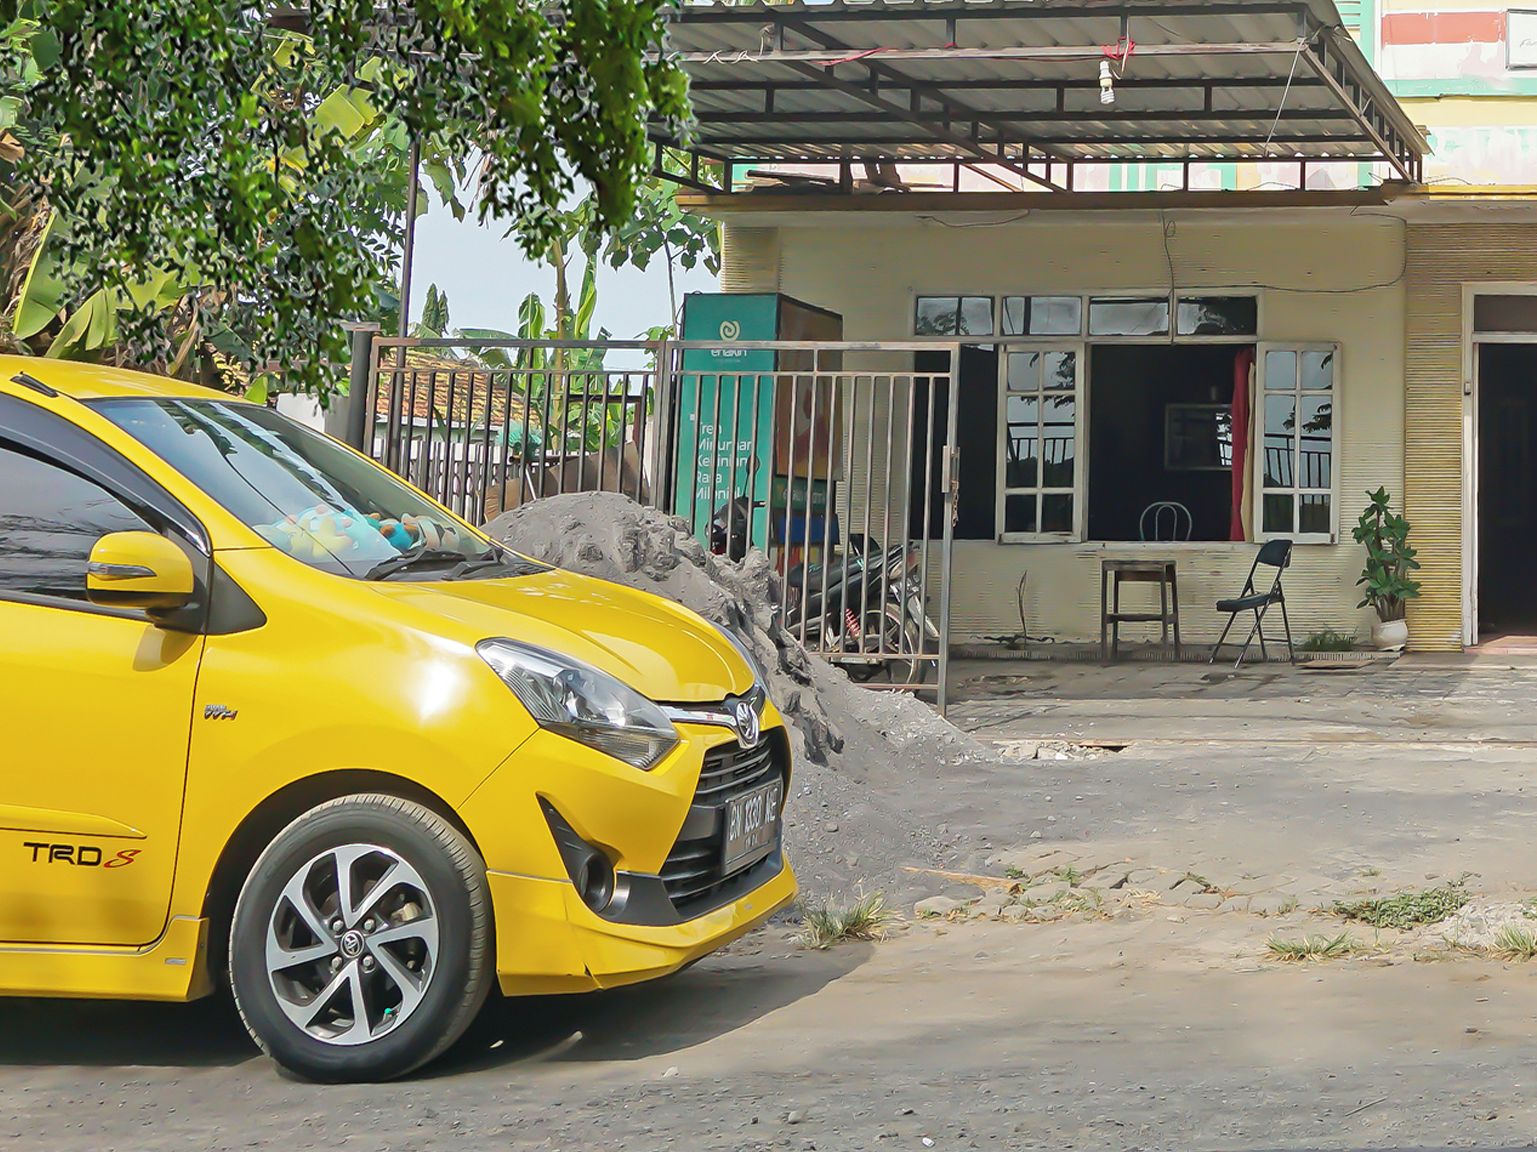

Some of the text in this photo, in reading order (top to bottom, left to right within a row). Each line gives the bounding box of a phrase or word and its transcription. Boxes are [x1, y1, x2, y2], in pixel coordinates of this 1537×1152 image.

[699, 422, 722, 435] re
[697, 471, 722, 483] Raa
[696, 486, 741, 499] Milnil
[24, 842, 142, 868] TRD S
